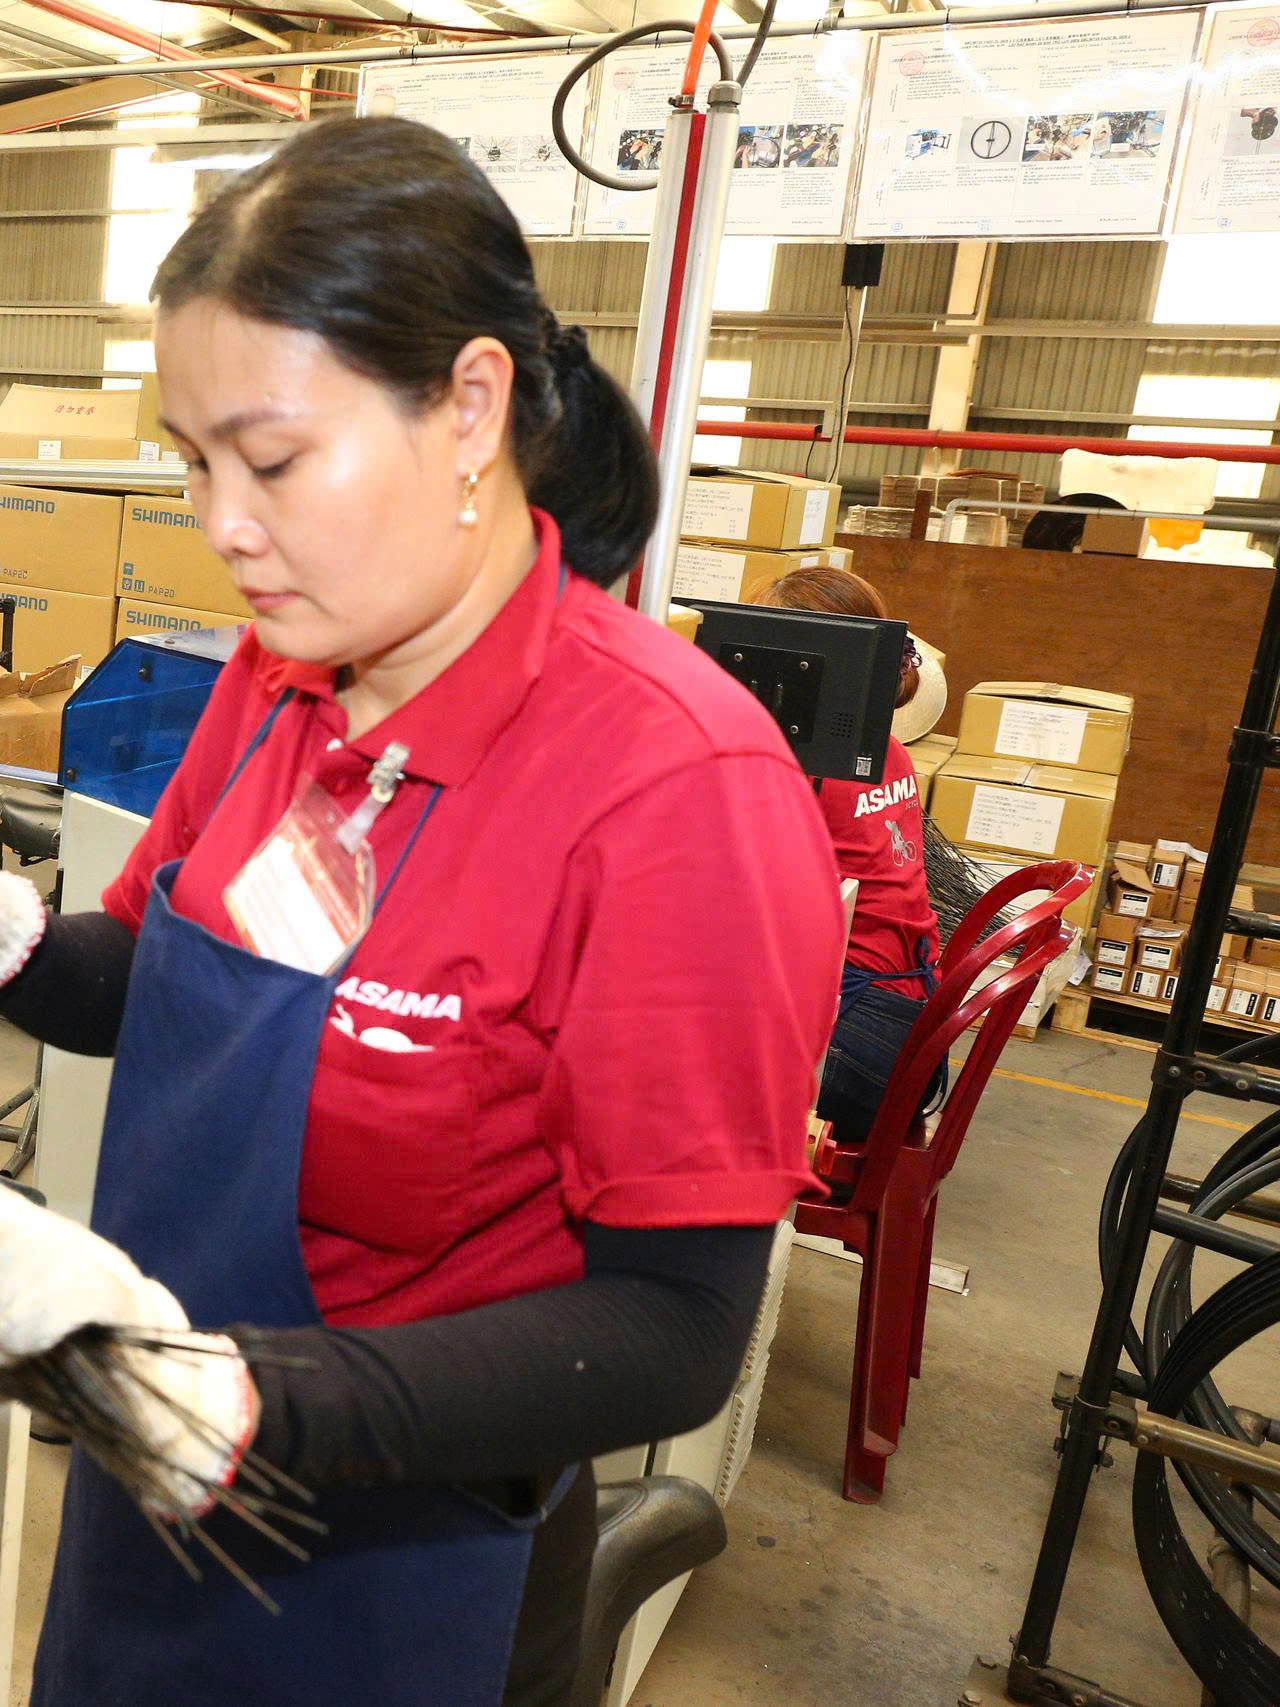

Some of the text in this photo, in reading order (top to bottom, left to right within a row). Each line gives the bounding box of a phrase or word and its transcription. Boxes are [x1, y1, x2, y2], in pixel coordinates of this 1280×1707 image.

[132, 507, 201, 529] SHIMAN
[126, 610, 202, 633] SHIMANO
[853, 774, 918, 818] ASAMA
[334, 976, 462, 1022] ASAMA
